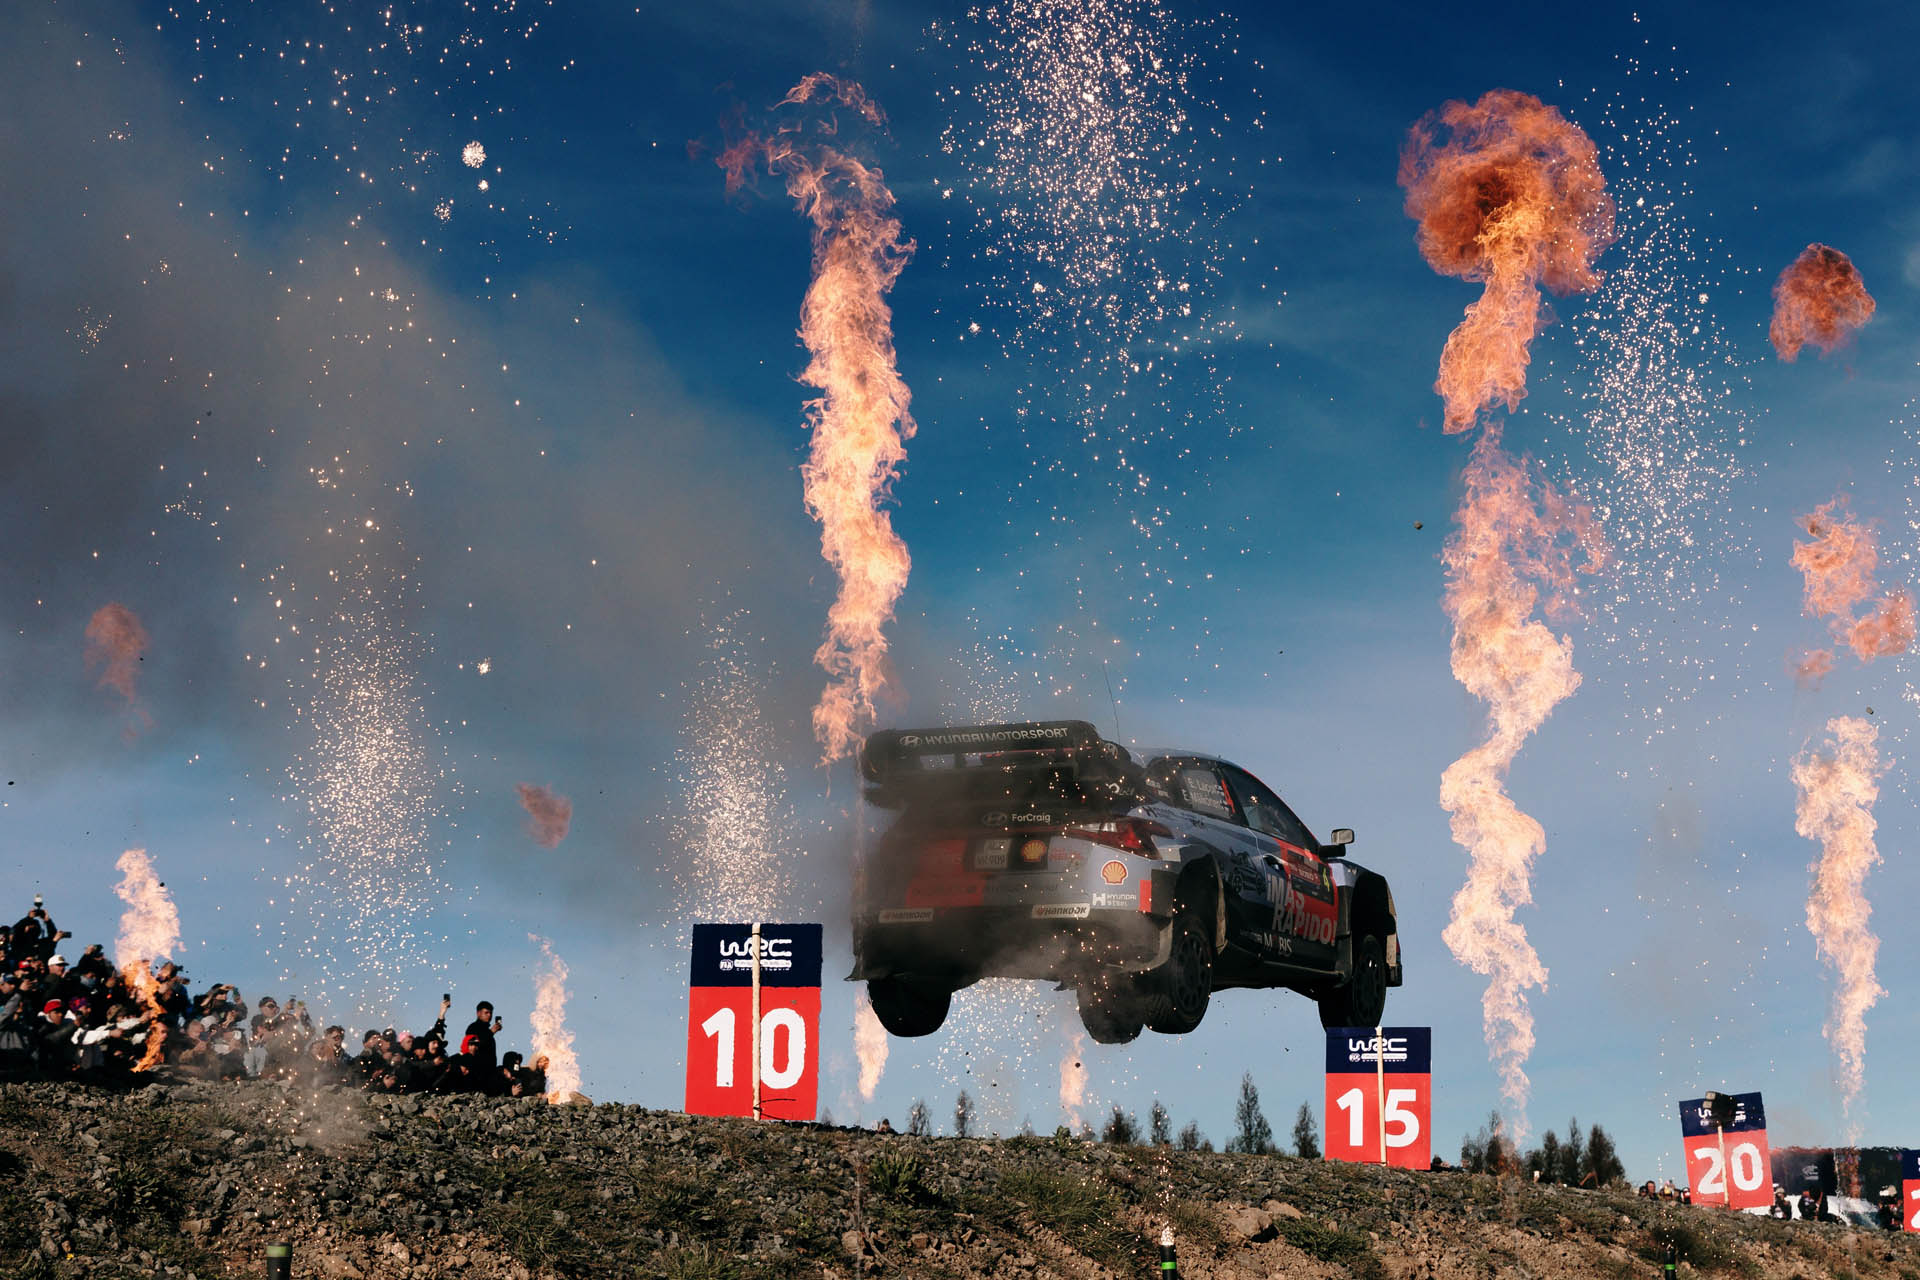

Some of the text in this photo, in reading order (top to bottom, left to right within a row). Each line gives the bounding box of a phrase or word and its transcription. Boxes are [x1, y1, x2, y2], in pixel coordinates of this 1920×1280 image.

[924, 728, 1069, 745] HYUNDAI MOTORSPORT
[1323, 867, 1330, 892] 4
[719, 938, 793, 957] WRC
[701, 1007, 806, 1090] 10
[1348, 1037, 1408, 1052] WRC
[1336, 1087, 1420, 1148] 15
[1693, 1142, 1764, 1194] 20
